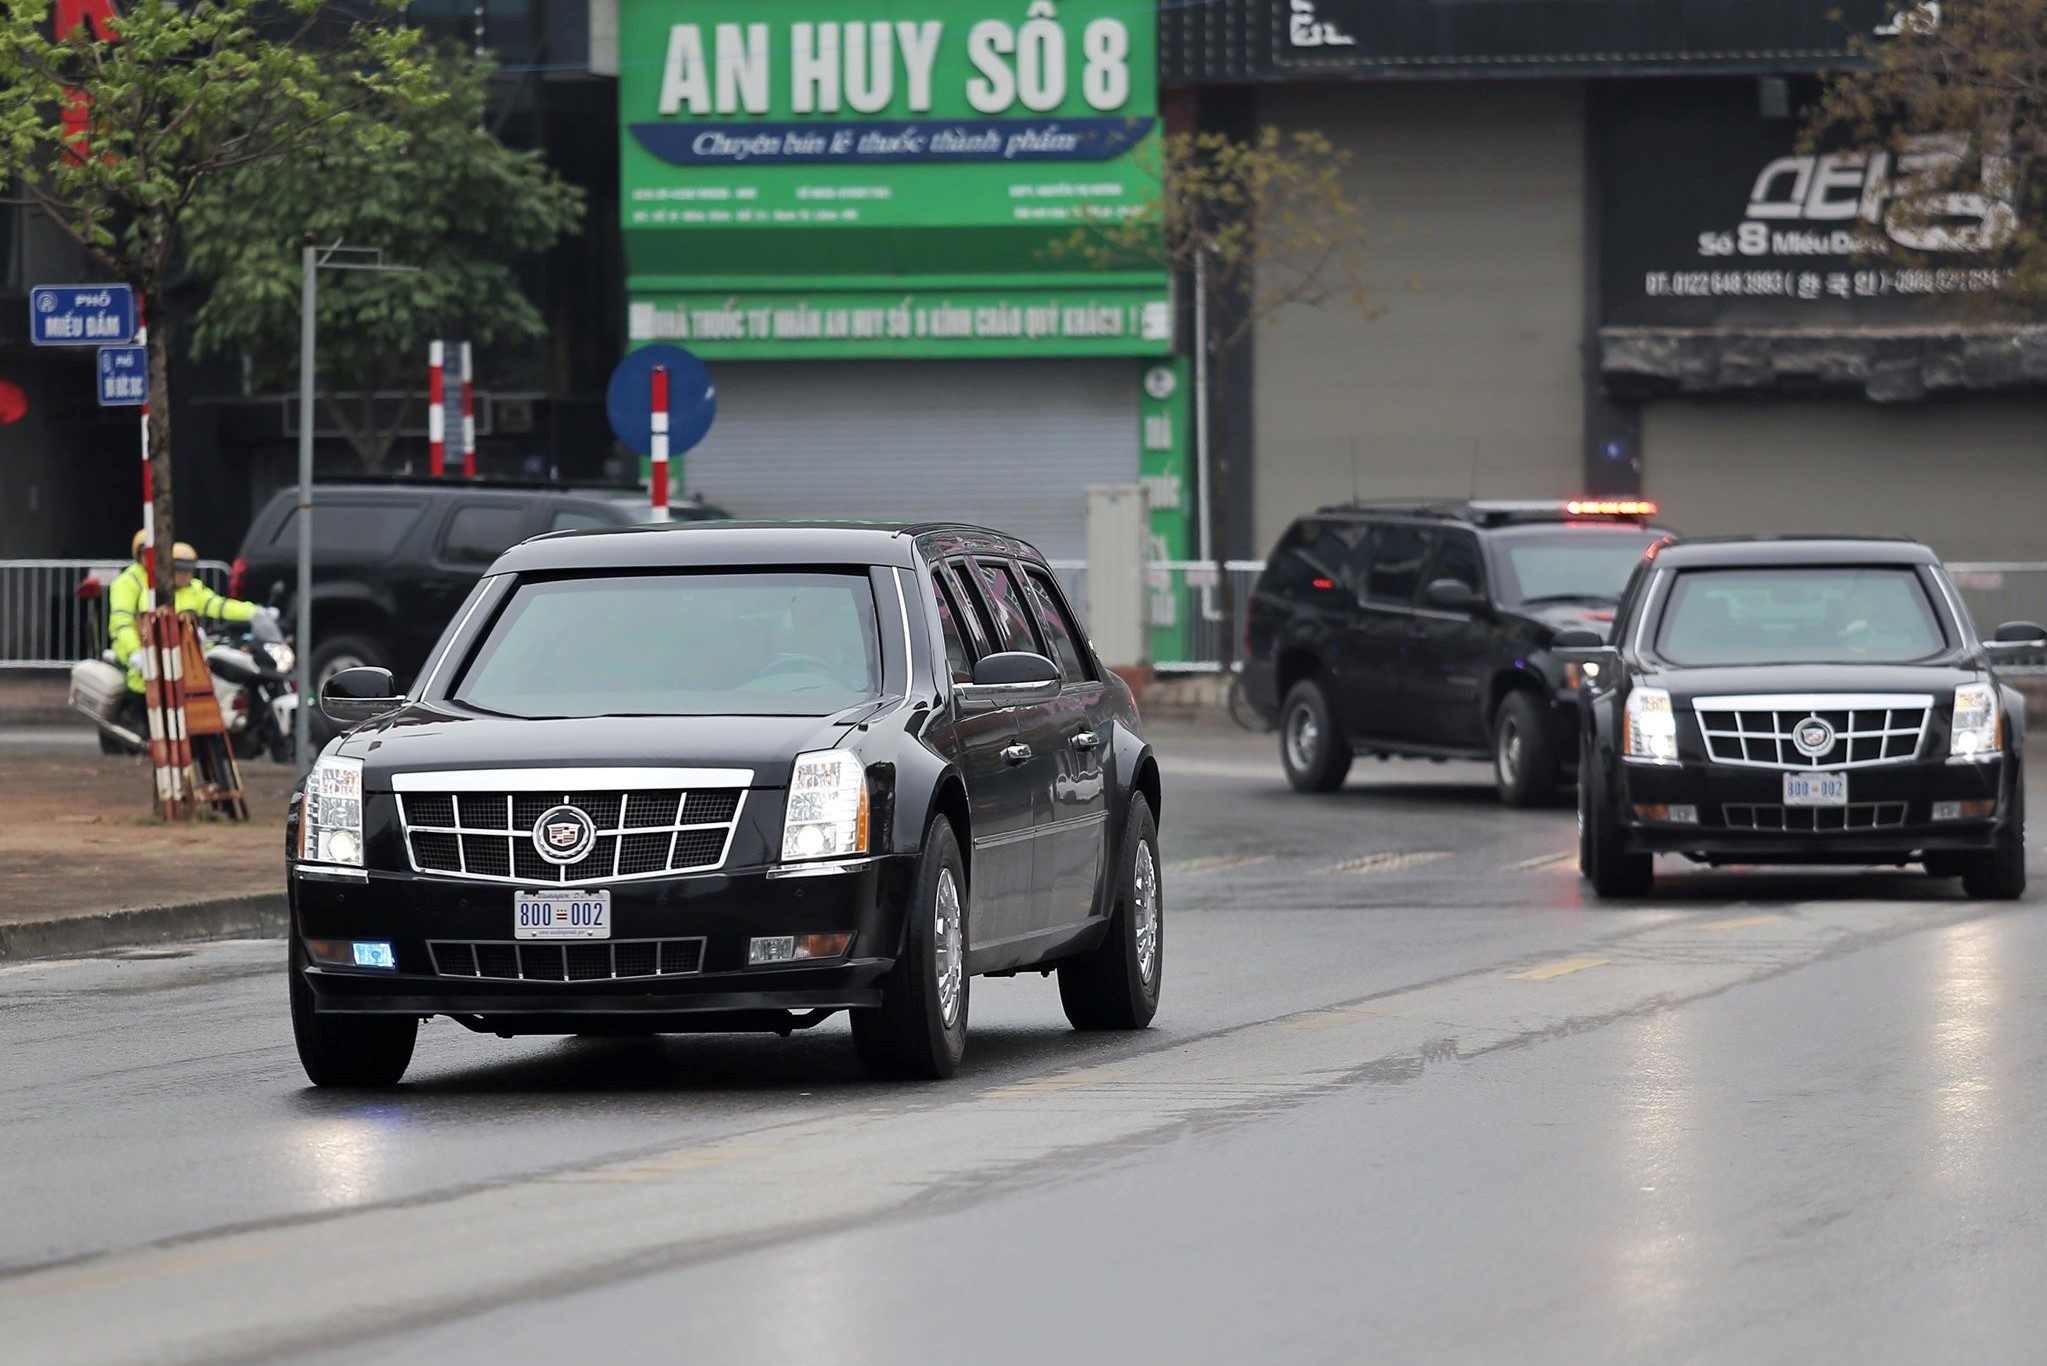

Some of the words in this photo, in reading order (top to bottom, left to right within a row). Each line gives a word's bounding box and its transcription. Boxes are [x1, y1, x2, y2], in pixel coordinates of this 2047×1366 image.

[658, 23, 769, 115] AN
[791, 19, 944, 113] HUY
[1083, 17, 1129, 111] 8
[1737, 221, 1769, 256] 8
[1787, 780, 1809, 797] 800
[520, 902, 552, 927] 800
[571, 902, 603, 927] 002
